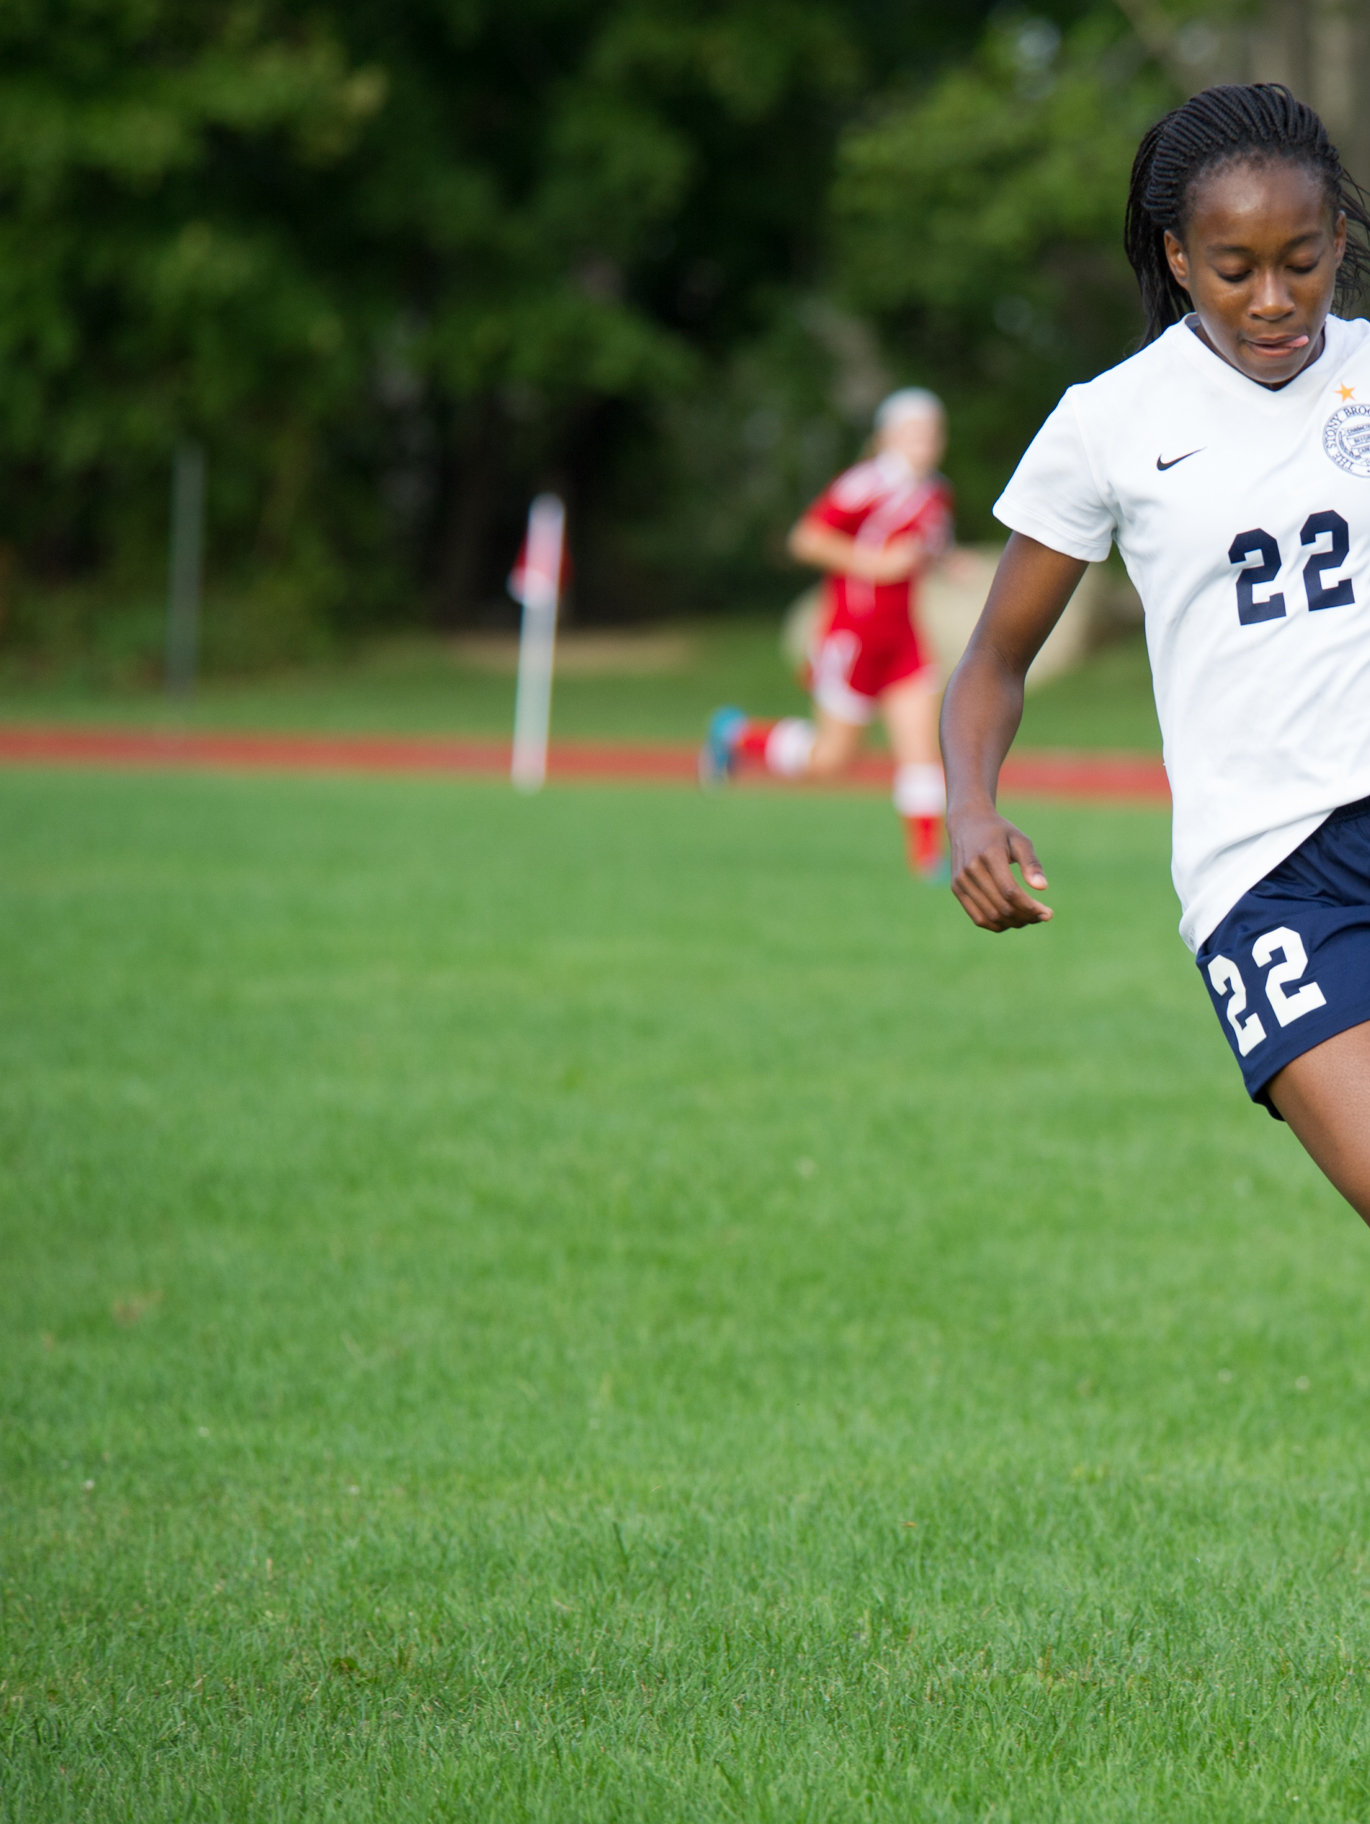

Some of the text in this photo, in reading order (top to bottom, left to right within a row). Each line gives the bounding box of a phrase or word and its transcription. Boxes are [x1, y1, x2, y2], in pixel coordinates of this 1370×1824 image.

[1325, 414, 1343, 449] STONY
[1333, 452, 1354, 471] THE
[1228, 509, 1355, 626] 22
[1207, 926, 1327, 1057] 22
